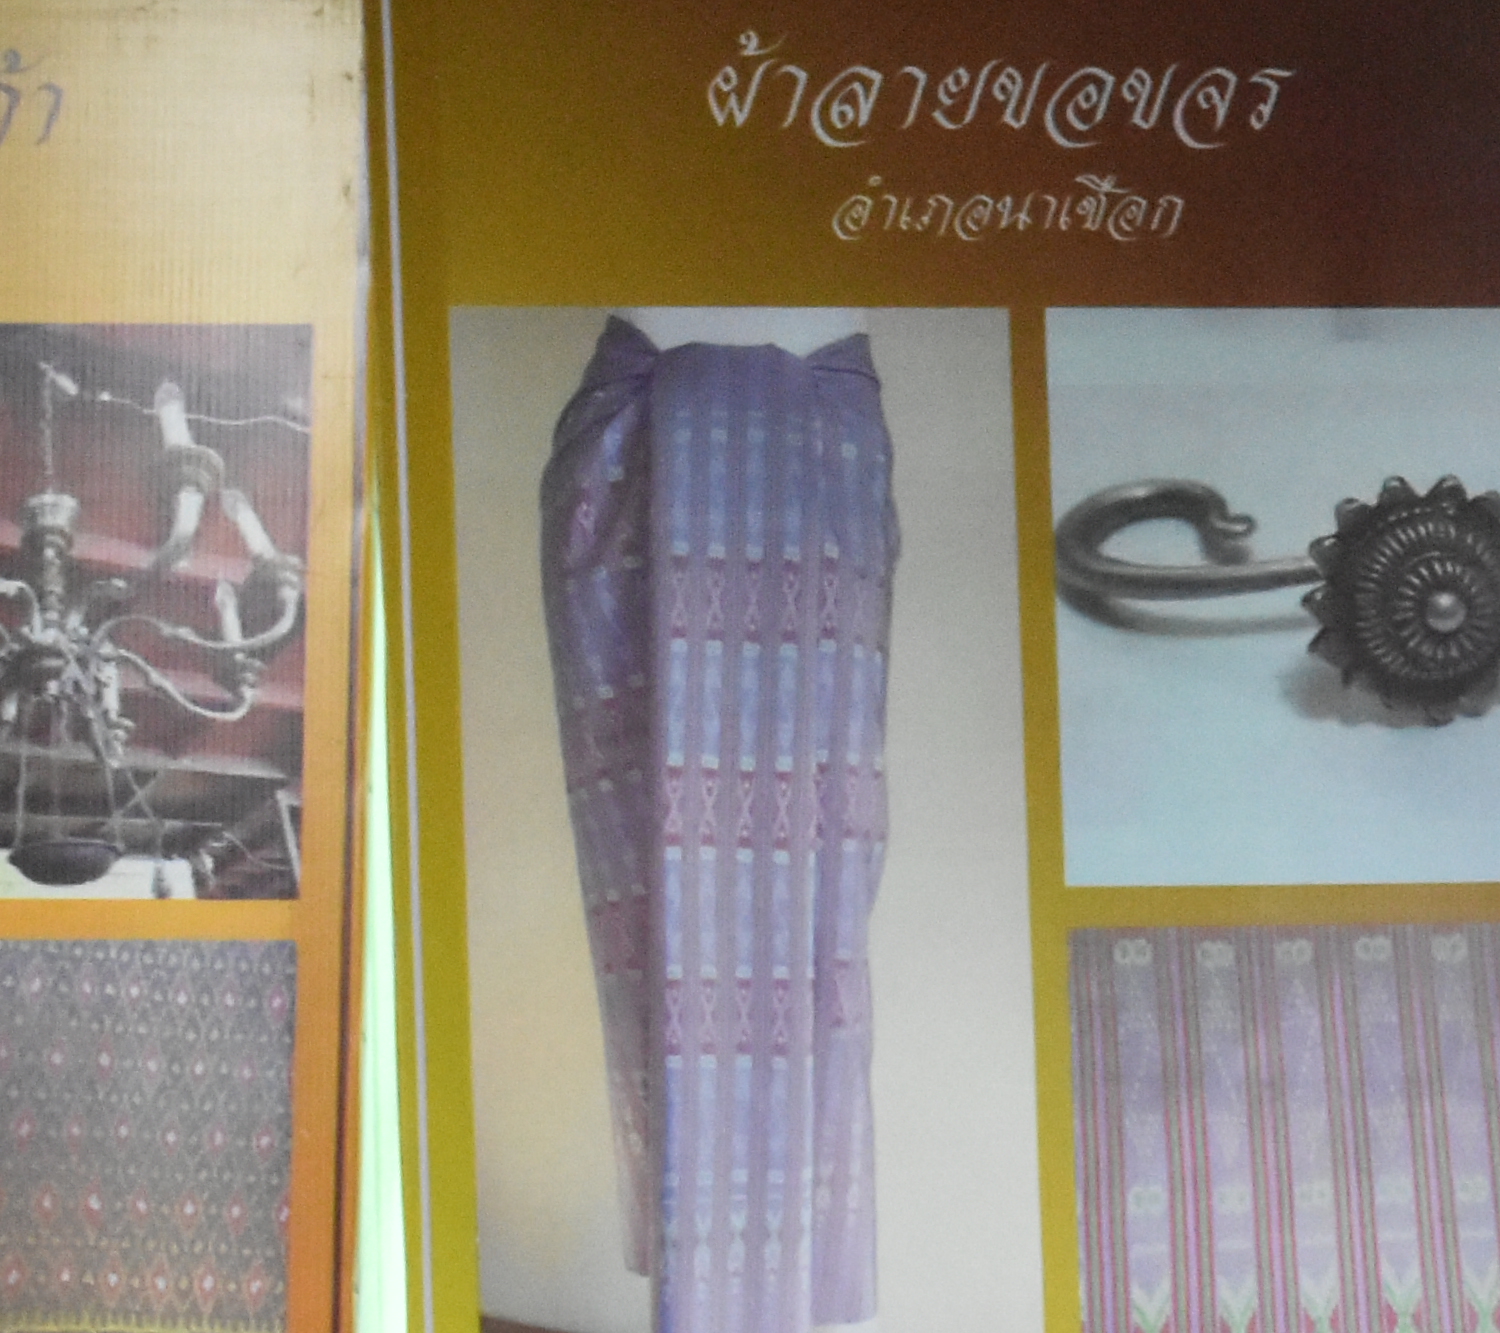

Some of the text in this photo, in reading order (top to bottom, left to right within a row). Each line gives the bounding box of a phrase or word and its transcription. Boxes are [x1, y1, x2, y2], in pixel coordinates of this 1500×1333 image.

[832, 174, 1184, 241] อำเภอนาเชือก
